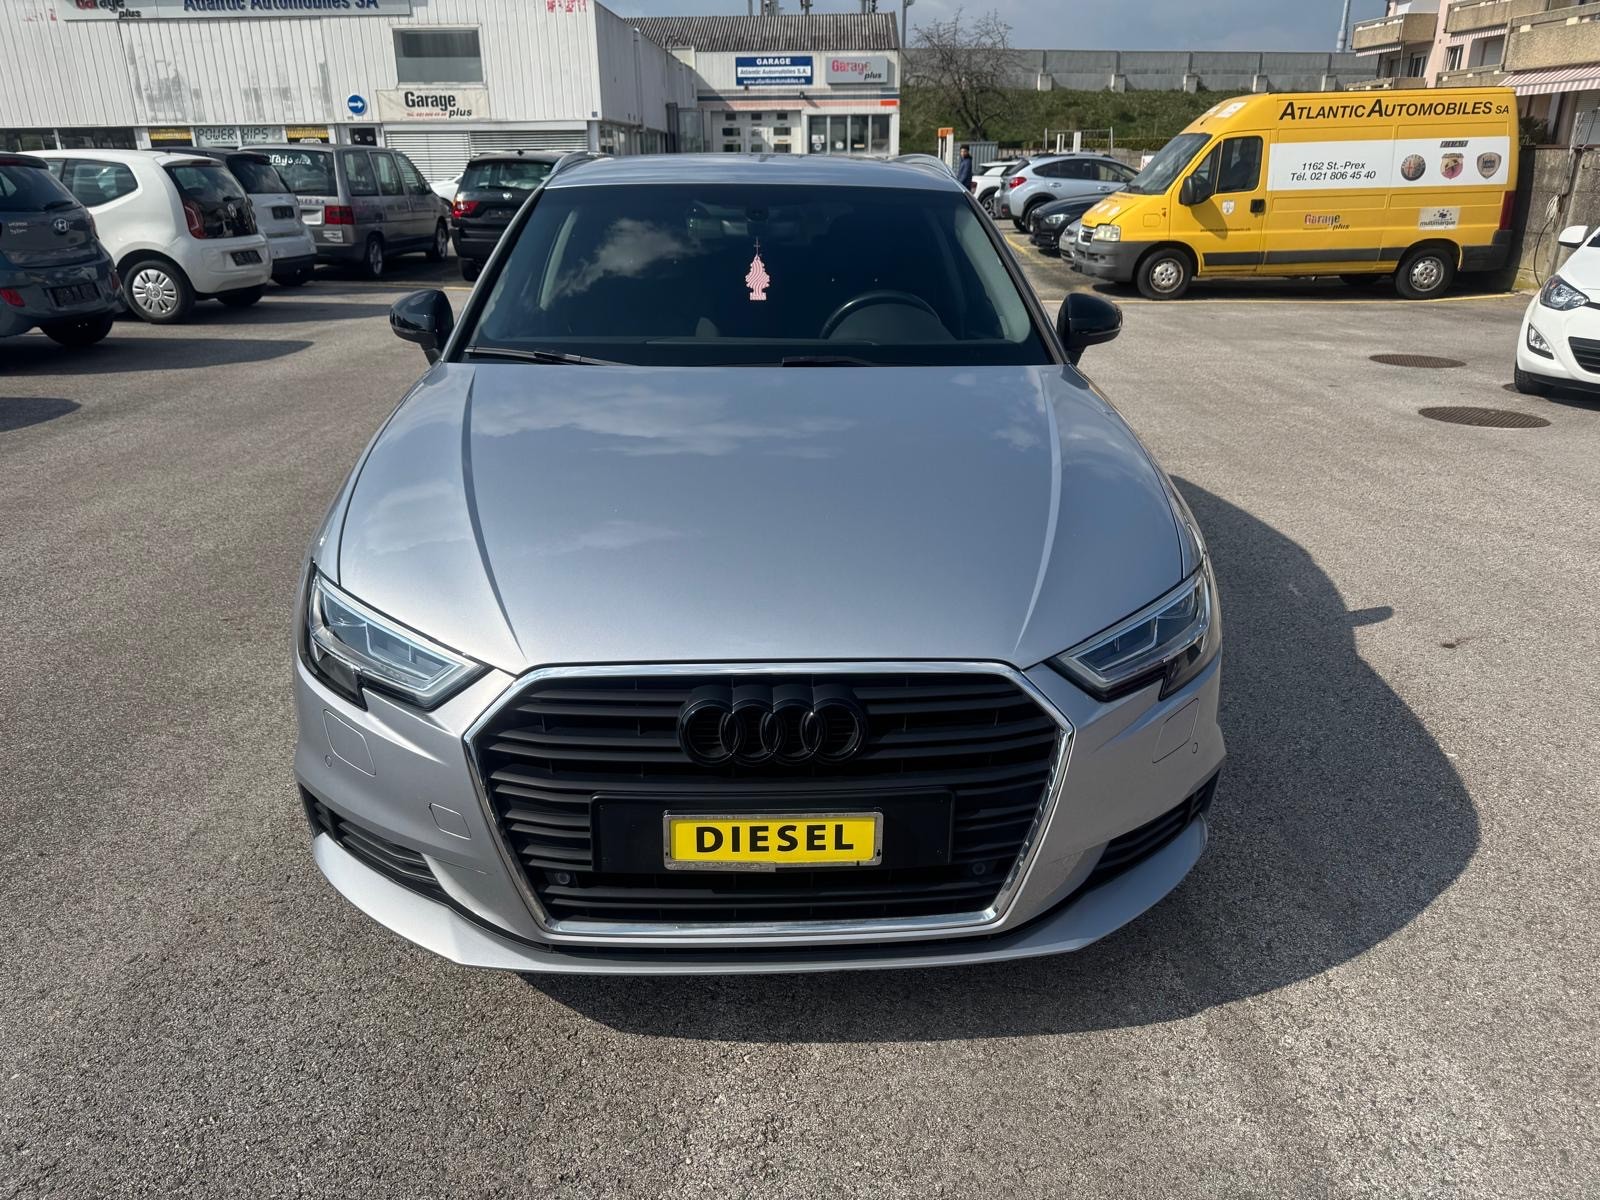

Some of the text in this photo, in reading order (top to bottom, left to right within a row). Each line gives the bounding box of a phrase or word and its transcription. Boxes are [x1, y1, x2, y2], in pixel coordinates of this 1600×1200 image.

[118, 9, 142, 20] plus
[756, 57, 791, 65] GARAGE
[832, 59, 872, 75] Garage
[864, 71, 882, 80] plus
[404, 91, 457, 111] Garage
[448, 107, 473, 118] plus
[1279, 98, 1510, 121] ATLANTIC AUTOMOBILES SA
[1302, 161, 1366, 171] 1162 St.-Prex
[1291, 170, 1376, 181] Tél. 021 806 45 40
[1304, 213, 1341, 226] Garage
[1332, 223, 1350, 231] plus
[695, 824, 854, 853] DIESEL
